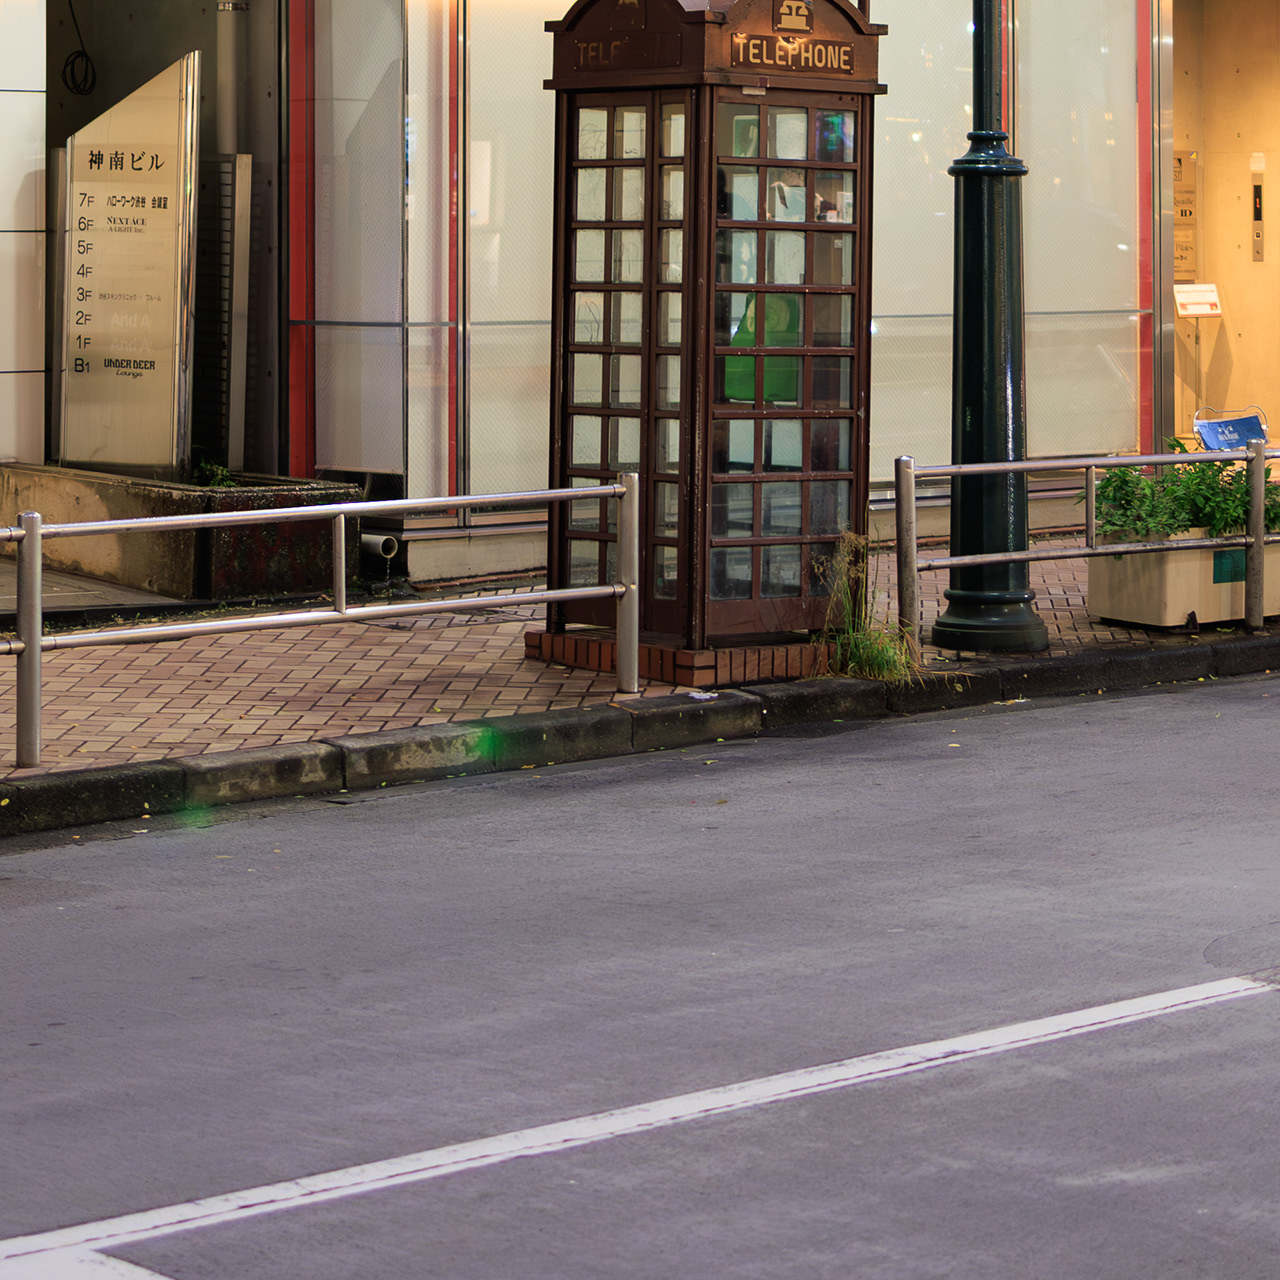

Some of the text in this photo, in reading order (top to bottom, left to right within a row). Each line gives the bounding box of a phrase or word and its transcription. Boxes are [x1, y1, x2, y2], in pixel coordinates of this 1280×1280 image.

[736, 38, 852, 70] TELEPHONE
[88, 150, 165, 171] 神南ビル
[79, 192, 95, 208] 7F
[78, 216, 94, 232] 6F
[107, 215, 131, 225] NEXT
[77, 239, 94, 255] 5F
[76, 263, 93, 278] 4F
[76, 286, 93, 302] 3F
[75, 310, 93, 326] 2F
[76, 334, 92, 350] 1F
[74, 357, 90, 374] B1
[104, 358, 156, 370] UNDER DEER
[115, 369, 143, 379] Lounge
